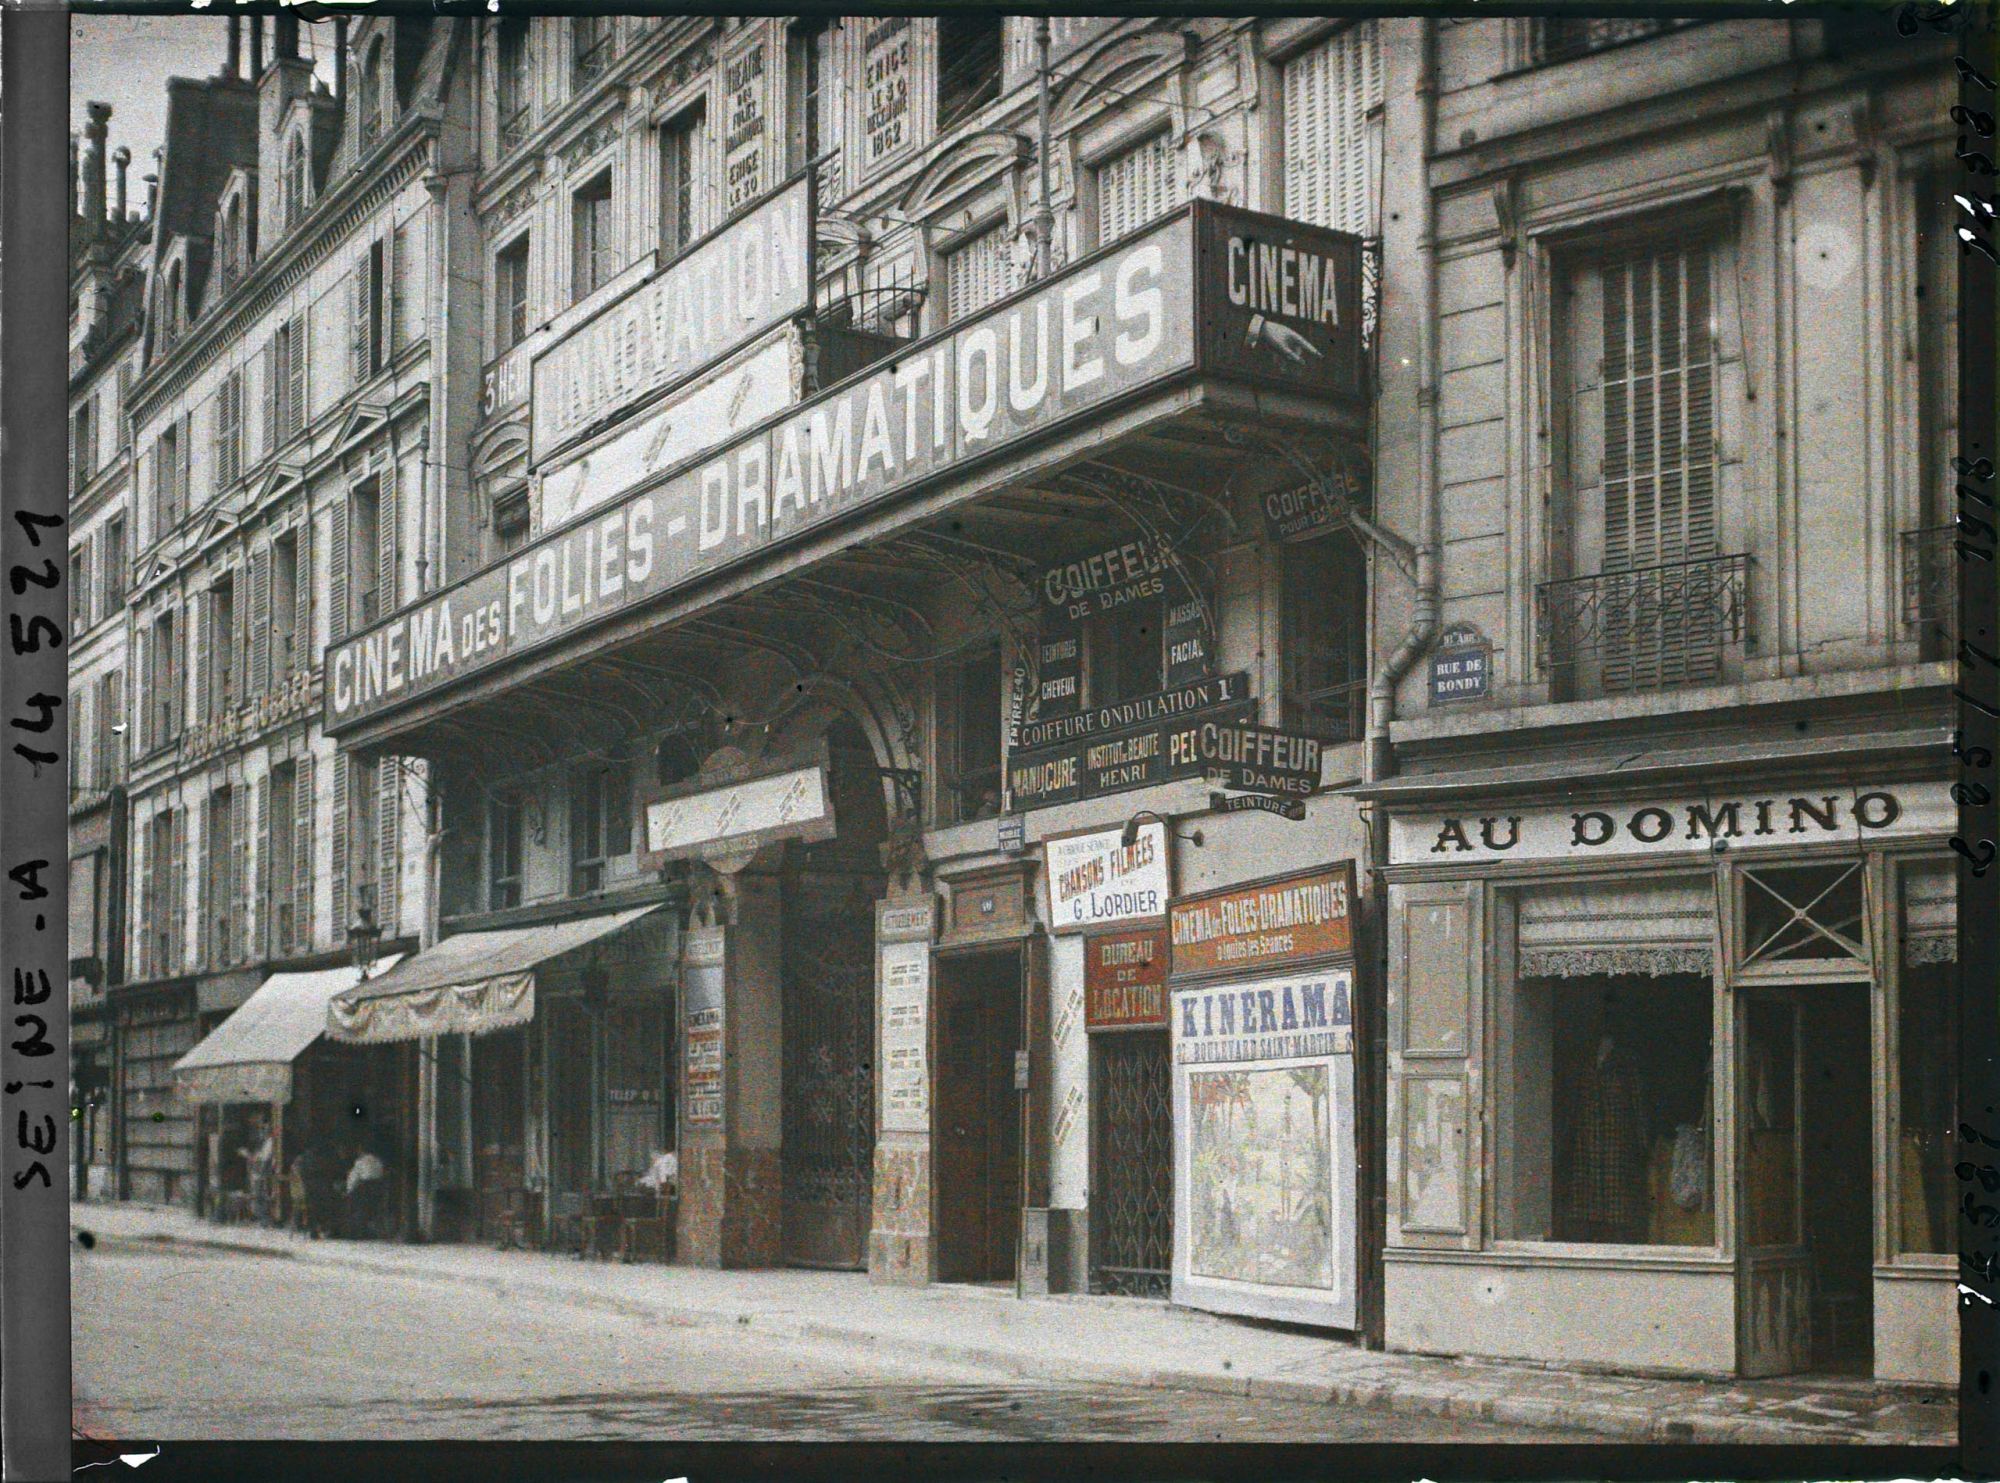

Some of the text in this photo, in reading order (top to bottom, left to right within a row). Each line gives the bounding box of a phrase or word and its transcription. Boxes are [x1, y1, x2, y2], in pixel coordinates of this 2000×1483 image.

[871, 89, 883, 110] LE
[484, 371, 496, 417] 3
[332, 598, 455, 714] CINEMA
[461, 600, 502, 655] DES
[507, 497, 654, 639] FOLIES
[698, 245, 1164, 552] DRAMATIQUES
[1068, 577, 1165, 620] DE DAMES
[1170, 638, 1205, 666] FACIAL
[1436, 659, 1482, 676] RUE DE
[1041, 676, 1077, 701] CHEVEUX
[1436, 676, 1482, 694] BONDY
[1022, 713, 1096, 747] COIFFURE
[1100, 686, 1210, 727] ONDULATION
[1087, 740, 1124, 771] INSTITUT
[1200, 722, 1320, 773] COIFFEUR
[1099, 763, 1147, 789] HENRI
[1206, 766, 1312, 796] DE DAMES
[1224, 796, 1289, 817] TEINTURE
[1430, 791, 1903, 853] AU DOMINO
[1058, 855, 1105, 904] CHANSONS
[1090, 889, 1159, 918] LORDIER
[1101, 939, 1154, 967] BUREAU
[1116, 968, 1137, 982] DE
[1093, 984, 1162, 1020] LOCATION
[1193, 1039, 1257, 1062] BOULEVARD
[1259, 1032, 1337, 1059] SAINT-MARTIN
